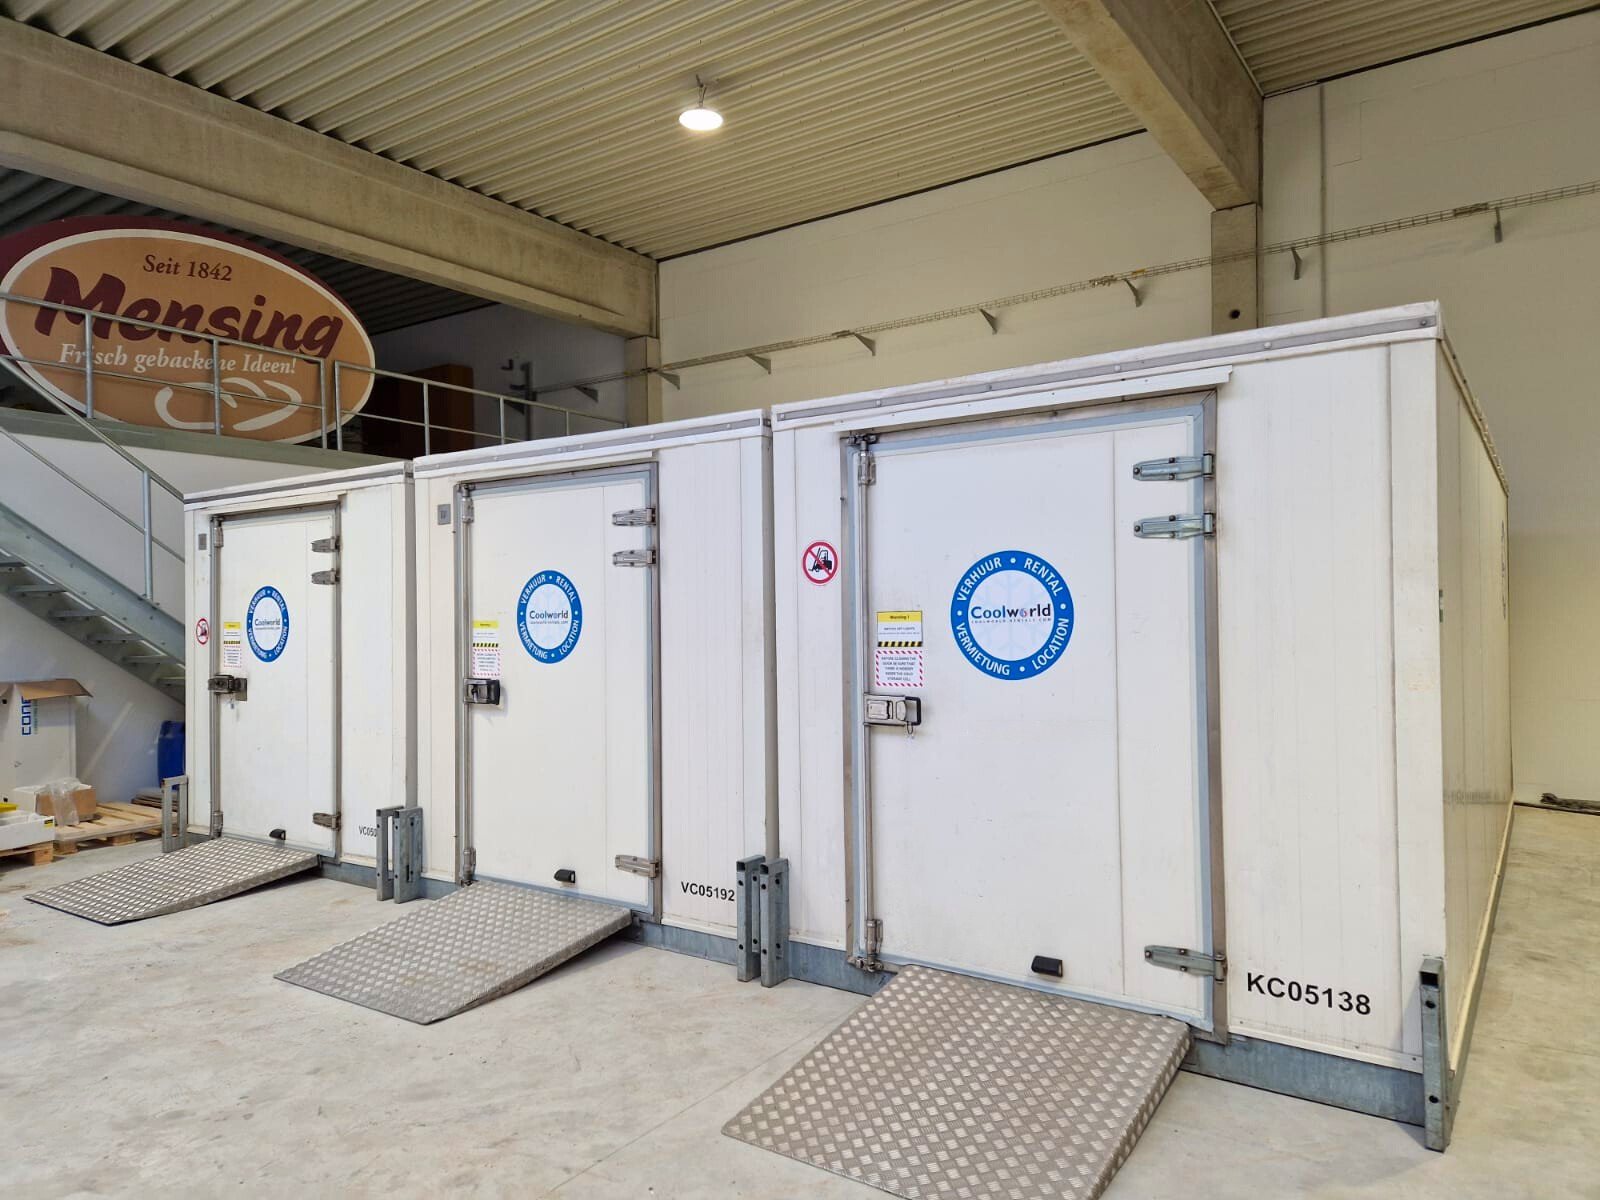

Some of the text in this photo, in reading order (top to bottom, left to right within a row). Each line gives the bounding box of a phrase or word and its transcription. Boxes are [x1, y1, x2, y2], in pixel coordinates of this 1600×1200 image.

[143, 254, 233, 282] Seit 1842
[34, 266, 344, 364] Mensing
[58, 343, 128, 366] Frsch
[241, 353, 297, 374] Ideen!
[520, 574, 546, 605] VERHUUR
[555, 575, 577, 603] RENTAL
[956, 556, 1003, 602] VERHUUR
[1023, 557, 1064, 597] RENTAL
[529, 610, 569, 619] Coolworld
[970, 603, 1052, 619] Coolworld
[519, 621, 548, 660] VERMIETUNG
[558, 619, 580, 655] LOCATION
[956, 622, 1011, 676] VERMIETUNG
[1031, 618, 1070, 670] LOCATION
[680, 880, 735, 902] VC05192
[1247, 972, 1371, 1015] KC05138
